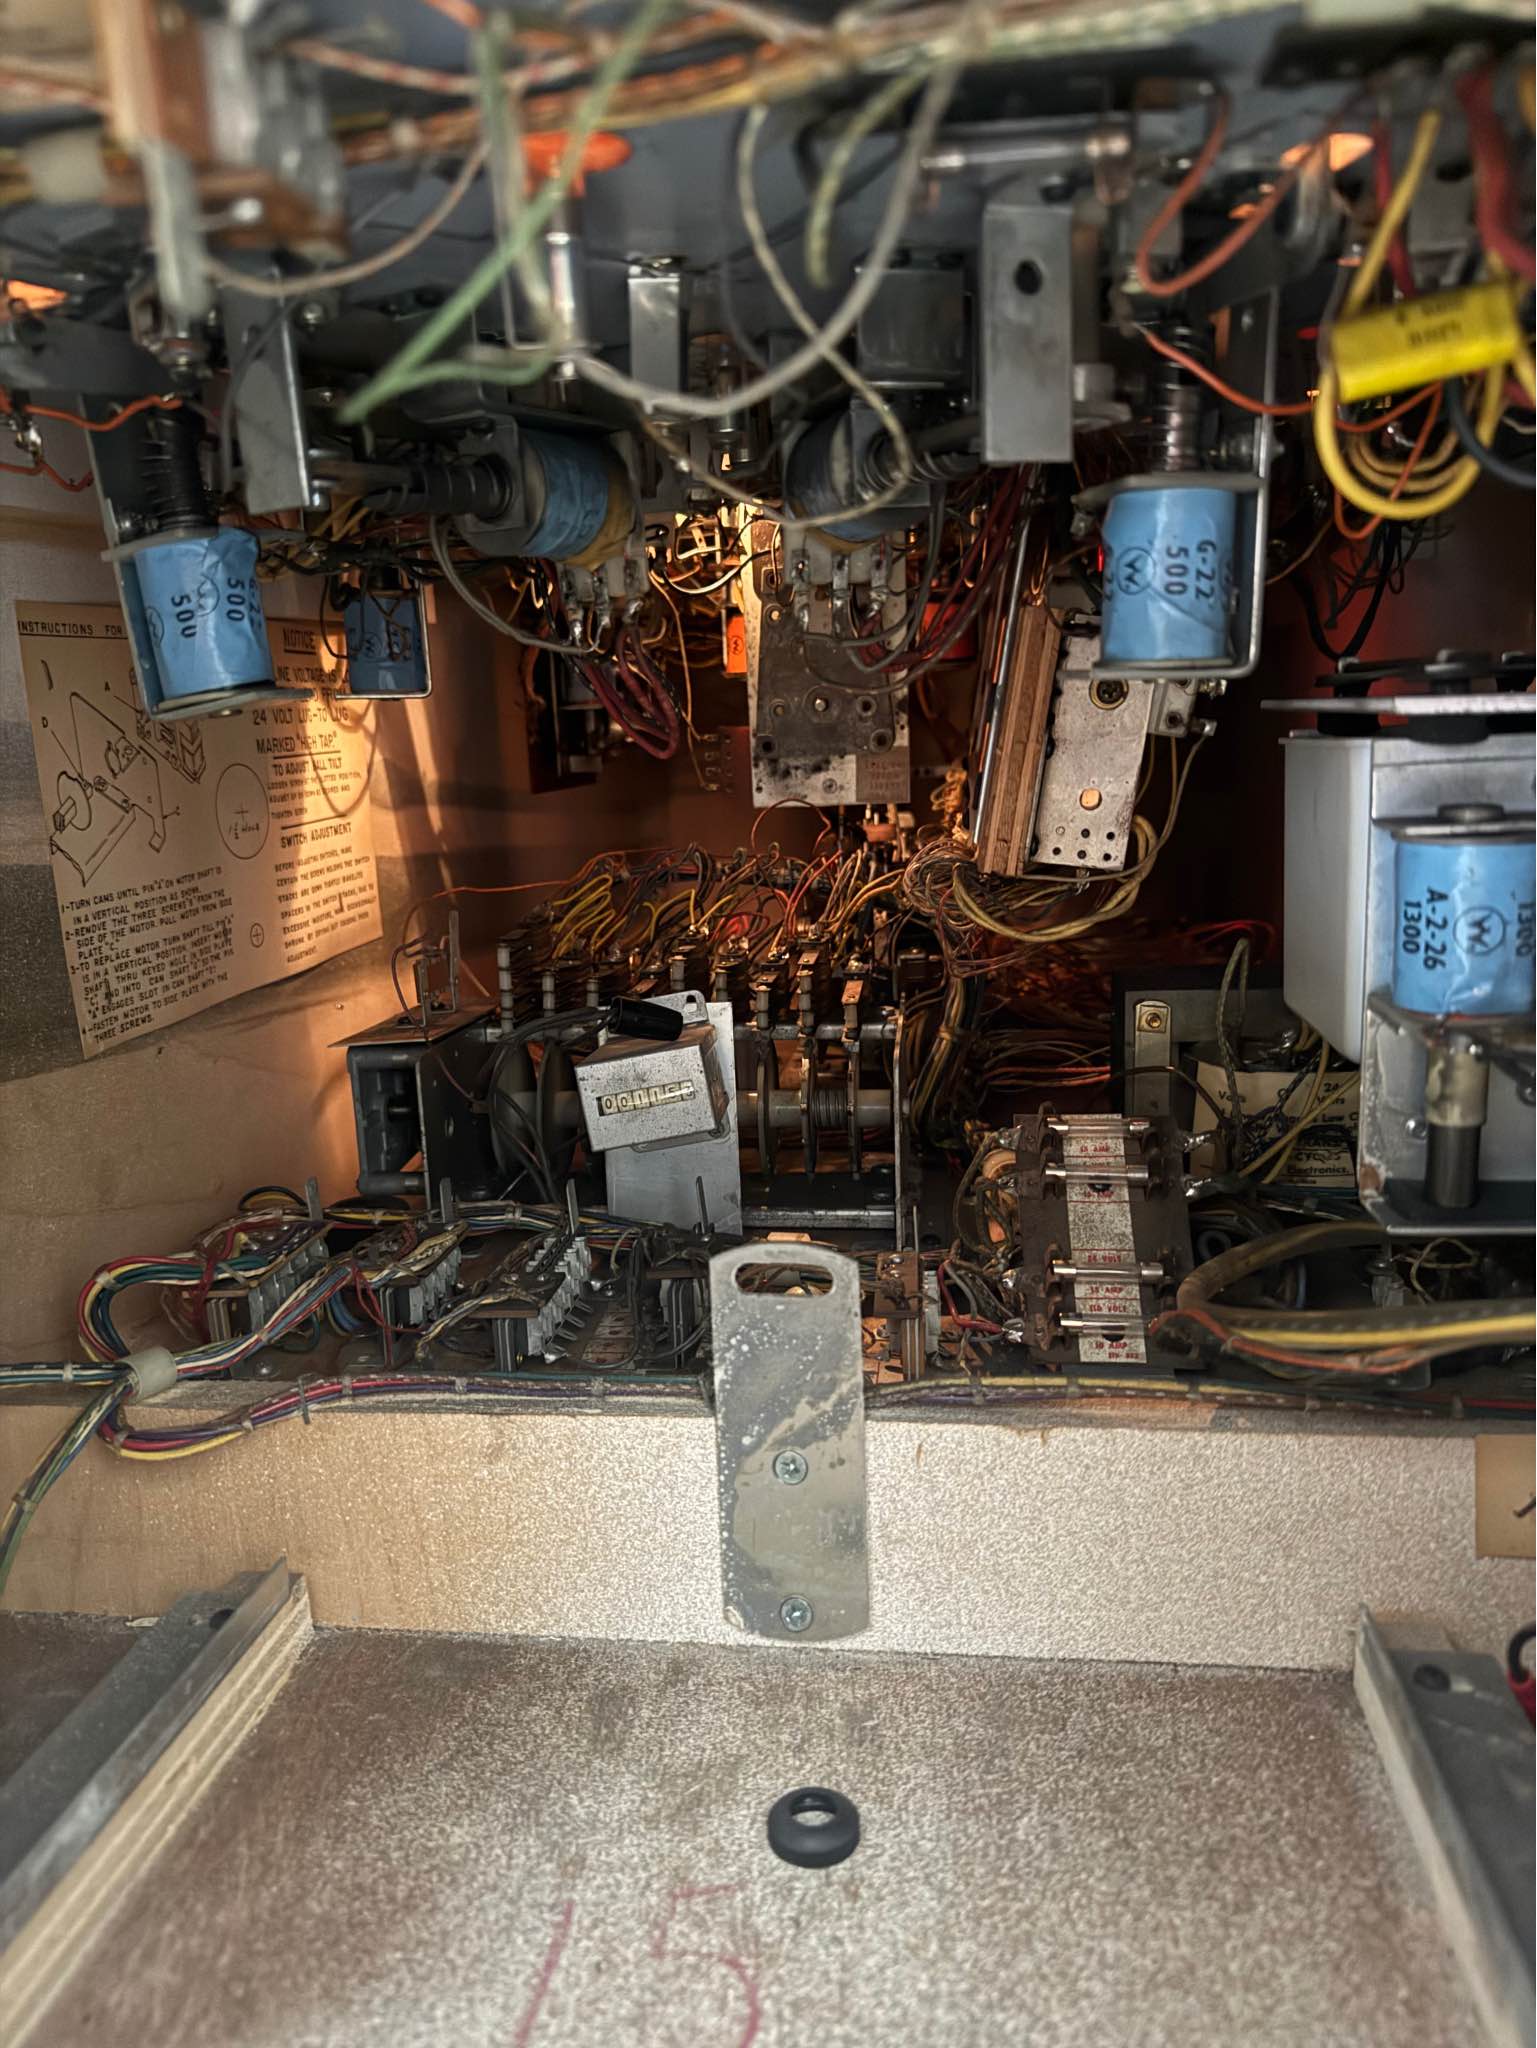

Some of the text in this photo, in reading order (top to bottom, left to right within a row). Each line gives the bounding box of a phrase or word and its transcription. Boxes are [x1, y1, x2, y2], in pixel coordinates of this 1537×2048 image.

[1164, 545, 1190, 596] 500
[1196, 540, 1217, 600] G-22
[226, 577, 246, 622] 500
[18, 621, 122, 636] INSTRUCTIONS FOR
[282, 627, 317, 650] NOTICE
[104, 681, 111, 692] A
[253, 709, 267, 725] 24
[272, 708, 293, 724] VOLT
[256, 736, 295, 753] MARKED
[272, 764, 283, 776] TO
[281, 822, 351, 848] SWITCH ADJUSTMENT
[117, 888, 139, 899] UNTIL
[73, 917, 82, 925] IN
[84, 915, 89, 923] A
[92, 905, 130, 921] VERTICAL
[134, 896, 167, 909] POSITION
[170, 892, 178, 900] AS
[112, 918, 128, 927] THE
[132, 911, 157, 922] THREE
[162, 902, 186, 914] SCREWS
[77, 938, 95, 949] SIDE
[98, 934, 107, 943] OF
[111, 929, 126, 940] THE
[160, 916, 176, 926] PULL
[1402, 901, 1423, 955] 1300
[1423, 886, 1449, 971] A-2-26
[78, 946, 102, 960] PLATE
[95, 951, 131, 967] REPLACE
[135, 942, 160, 955] MOTOR
[163, 935, 180, 947] TURN
[82, 975, 89, 984] IS
[93, 972, 102, 981] IN
[114, 958, 152, 973] VERTICAL
[156, 945, 186, 961] POSITION
[117, 973, 138, 985] THRU
[142, 964, 166, 977] KEYED
[123, 983, 141, 994] INTO
[140, 987, 158, 1001] SLOT
[123, 1004, 149, 1019] MOTOR
[152, 999, 162, 1009] TO
[94, 1029, 117, 1043] THREE
